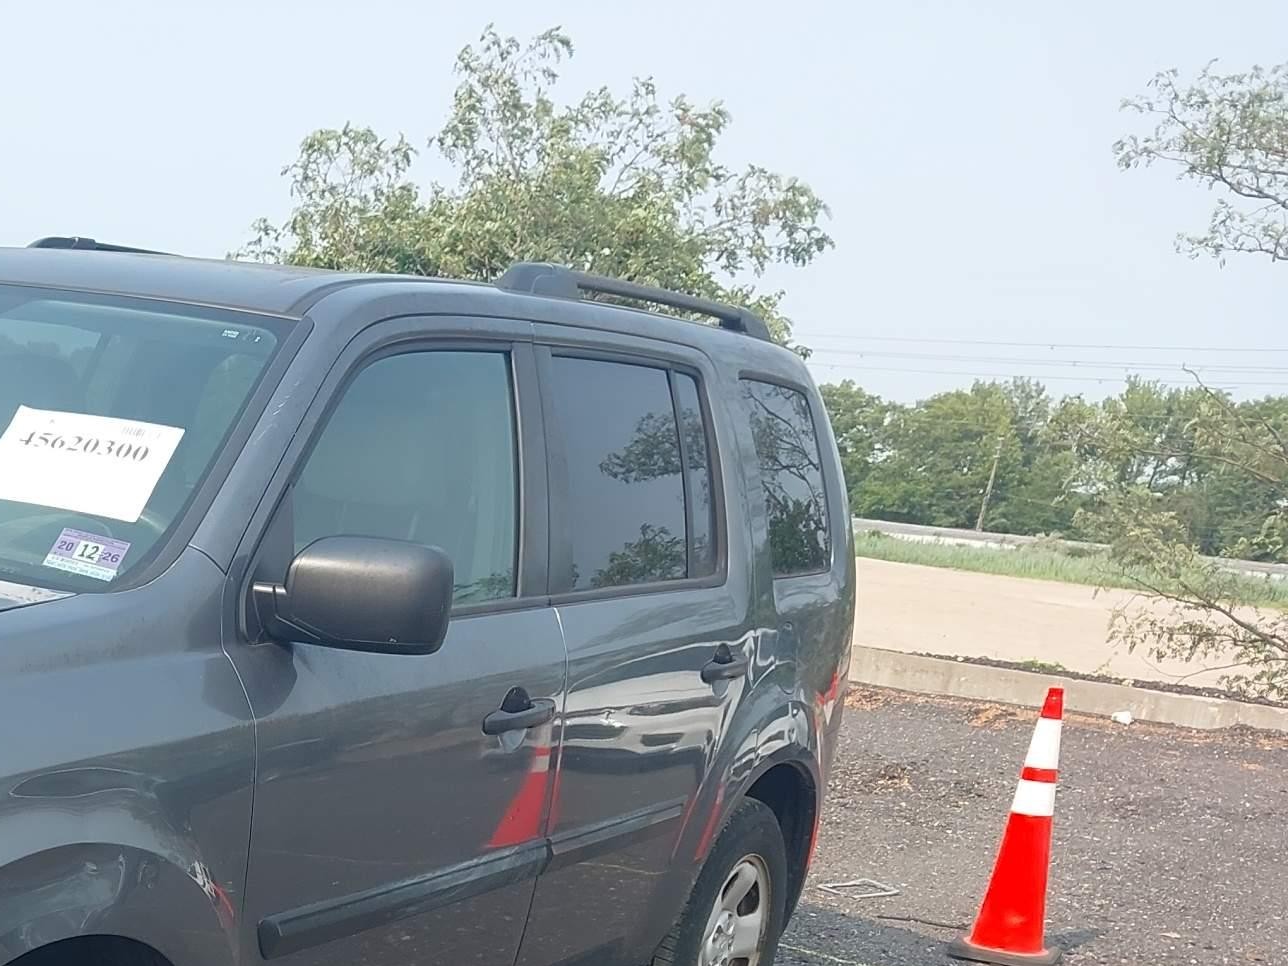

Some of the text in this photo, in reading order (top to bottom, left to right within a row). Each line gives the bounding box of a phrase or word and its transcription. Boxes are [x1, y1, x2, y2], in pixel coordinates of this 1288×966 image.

[19, 430, 150, 462] 45620300
[58, 541, 120, 563] 20 12 26
